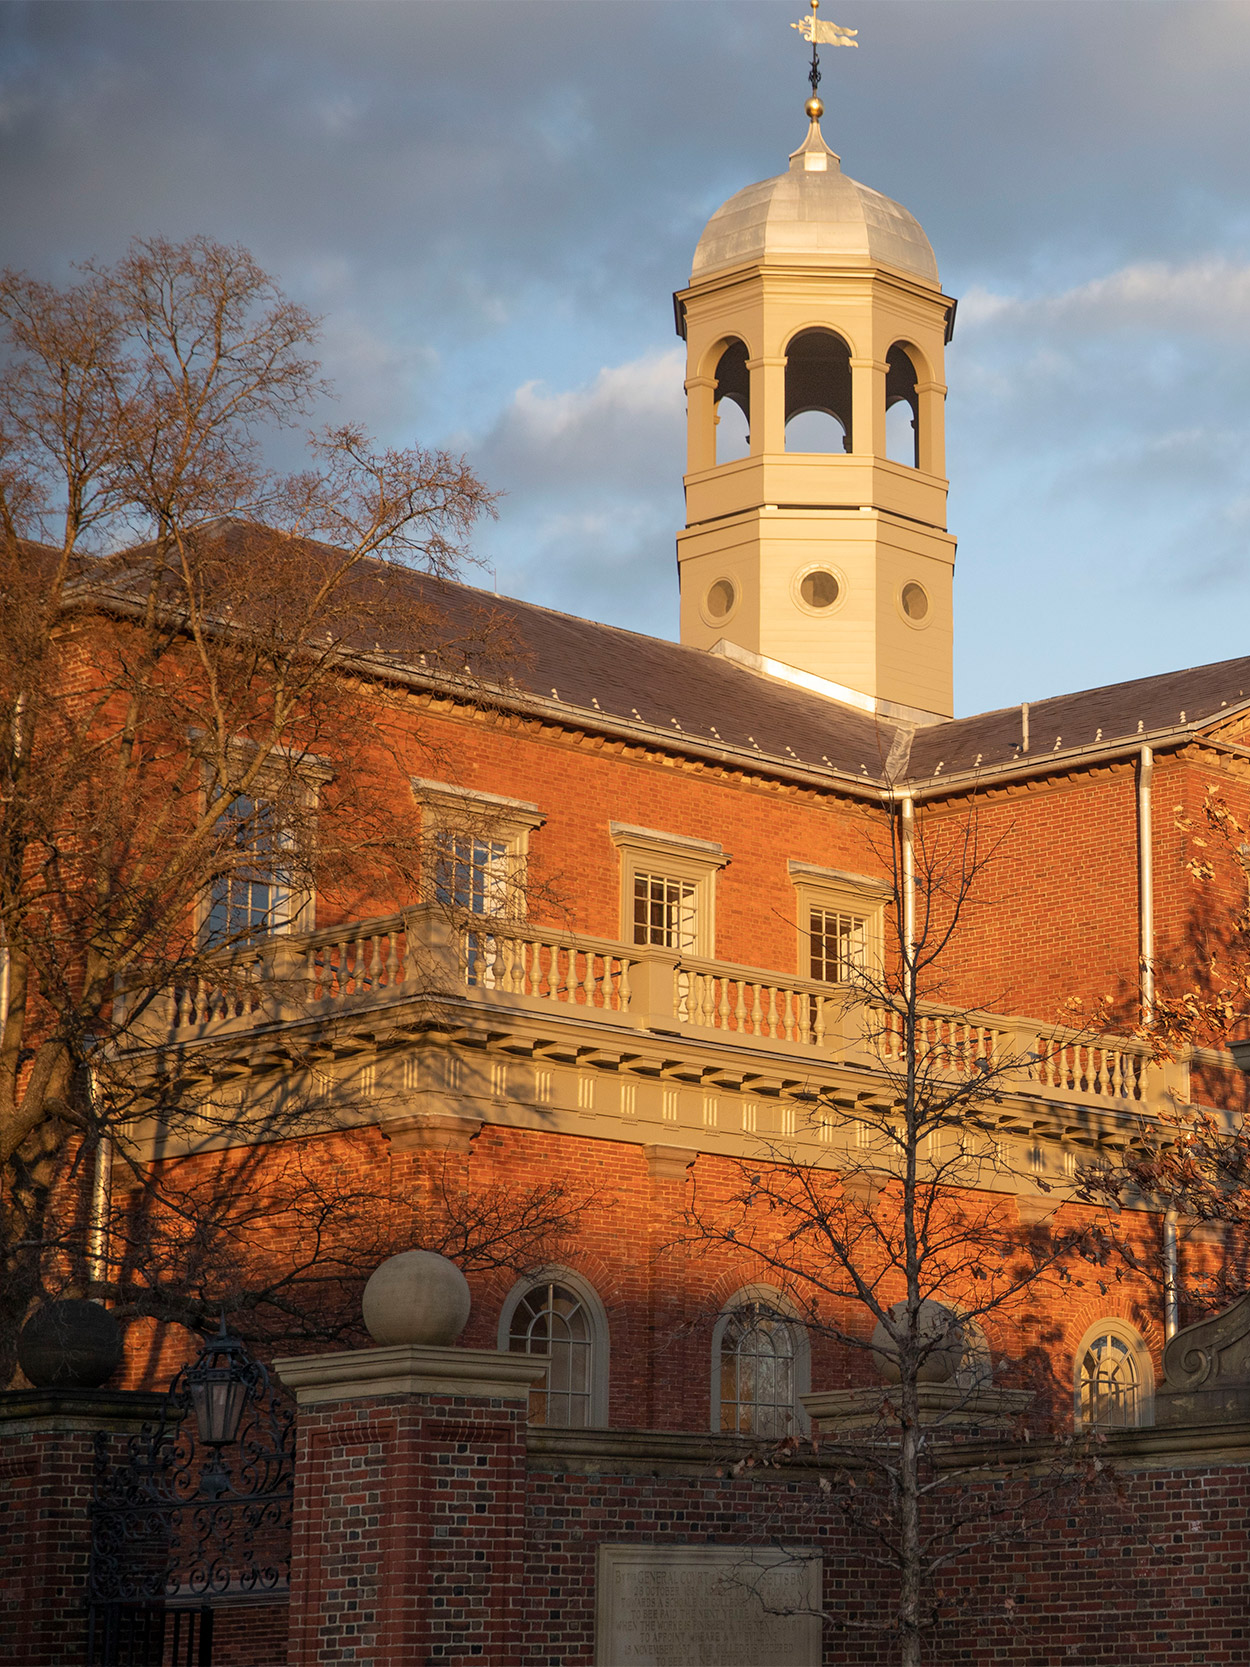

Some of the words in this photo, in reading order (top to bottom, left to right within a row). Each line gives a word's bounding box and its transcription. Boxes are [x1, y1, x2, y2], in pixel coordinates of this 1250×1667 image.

[638, 1571, 679, 1585] GENERAL
[646, 1587, 680, 1597] OCTOBER
[621, 1598, 656, 1608] TOWARDS
[631, 1610, 641, 1620] TO
[643, 1610, 658, 1620] BEE
[659, 1610, 678, 1620] PAID
[680, 1610, 696, 1620] THE
[616, 1621, 638, 1631] WHEN
[639, 1621, 656, 1631] THE
[657, 1621, 683, 1631] WORKE
[640, 1632, 650, 1643] TO
[653, 1632, 685, 1643] APPOINT
[634, 1644, 674, 1655] NOVEMBER
[656, 1656, 666, 1667] TO
[668, 1656, 683, 1667] BEE
